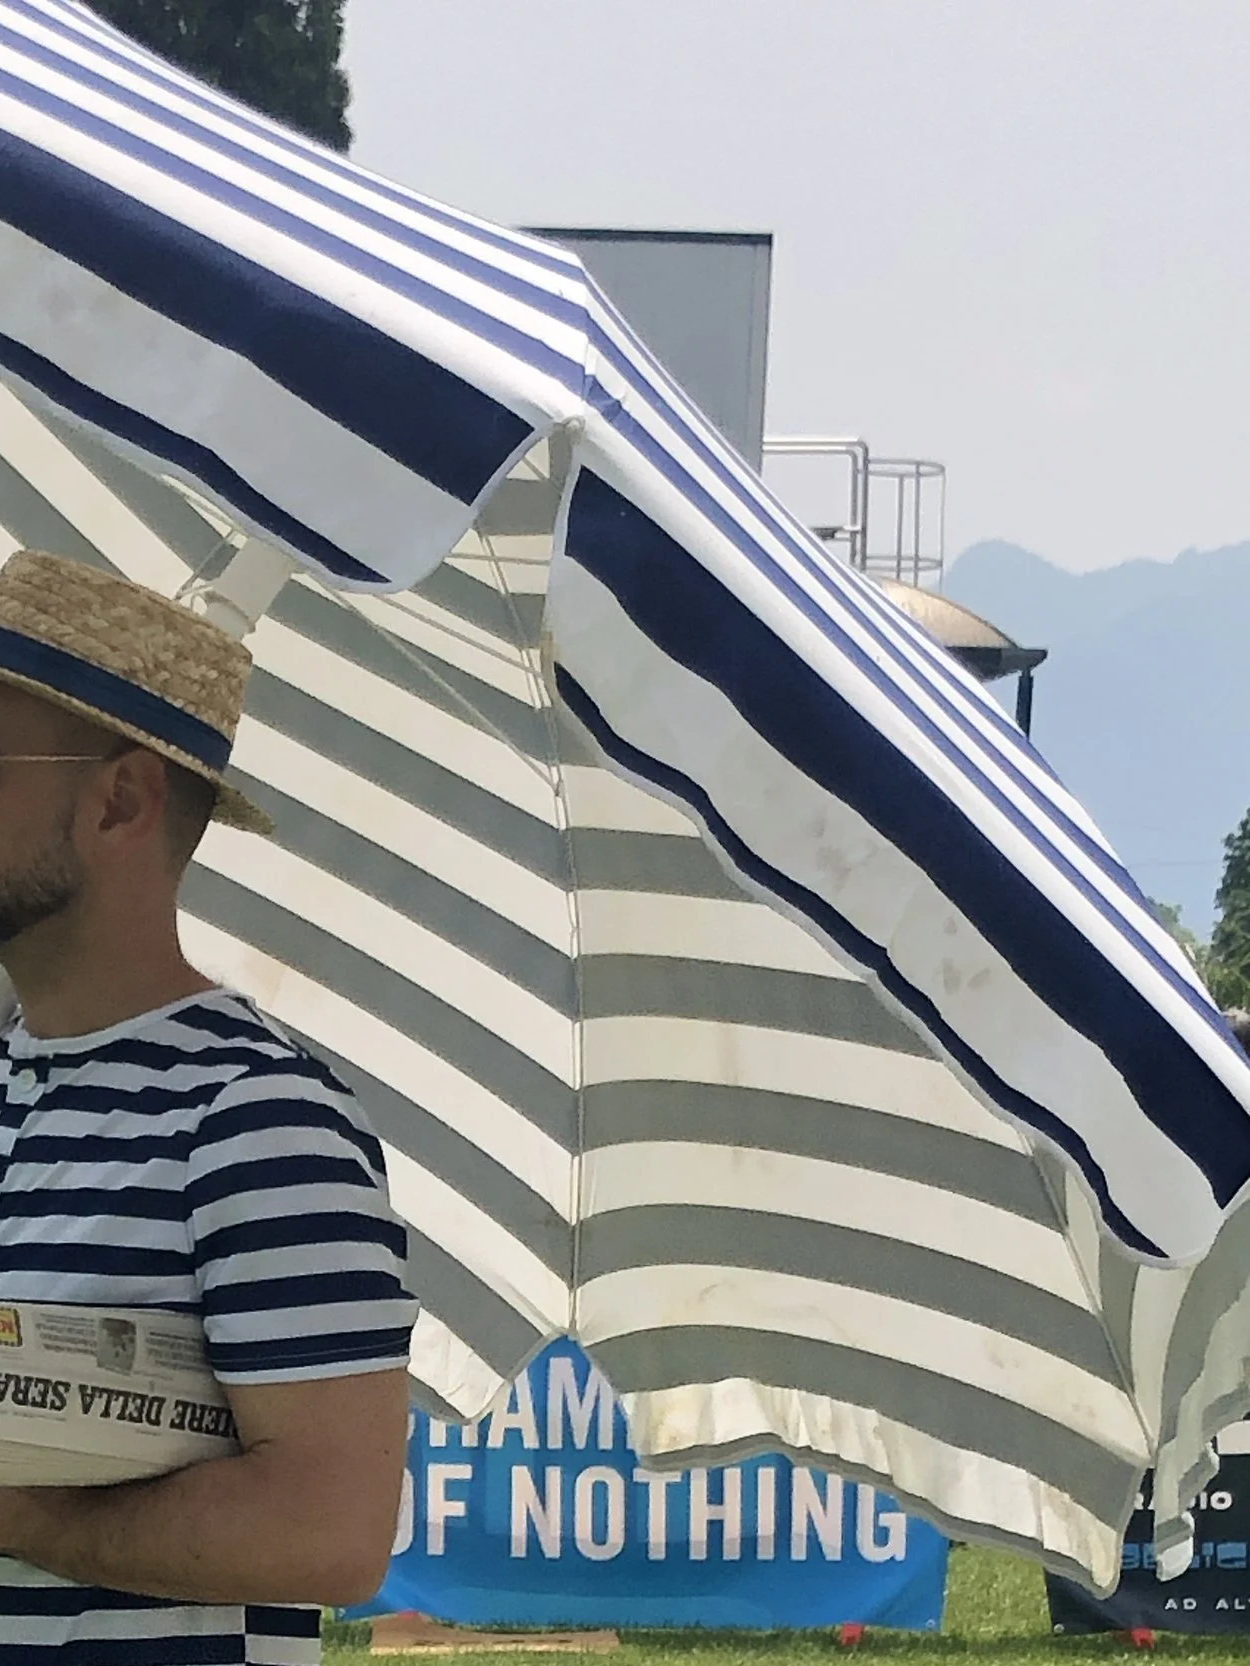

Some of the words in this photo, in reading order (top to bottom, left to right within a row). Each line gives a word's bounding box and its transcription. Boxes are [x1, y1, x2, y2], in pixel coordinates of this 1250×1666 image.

[78, 1383, 167, 1427] DELLA
[509, 1464, 907, 1562] NOTHING
[1164, 1598, 1198, 1610] AD
